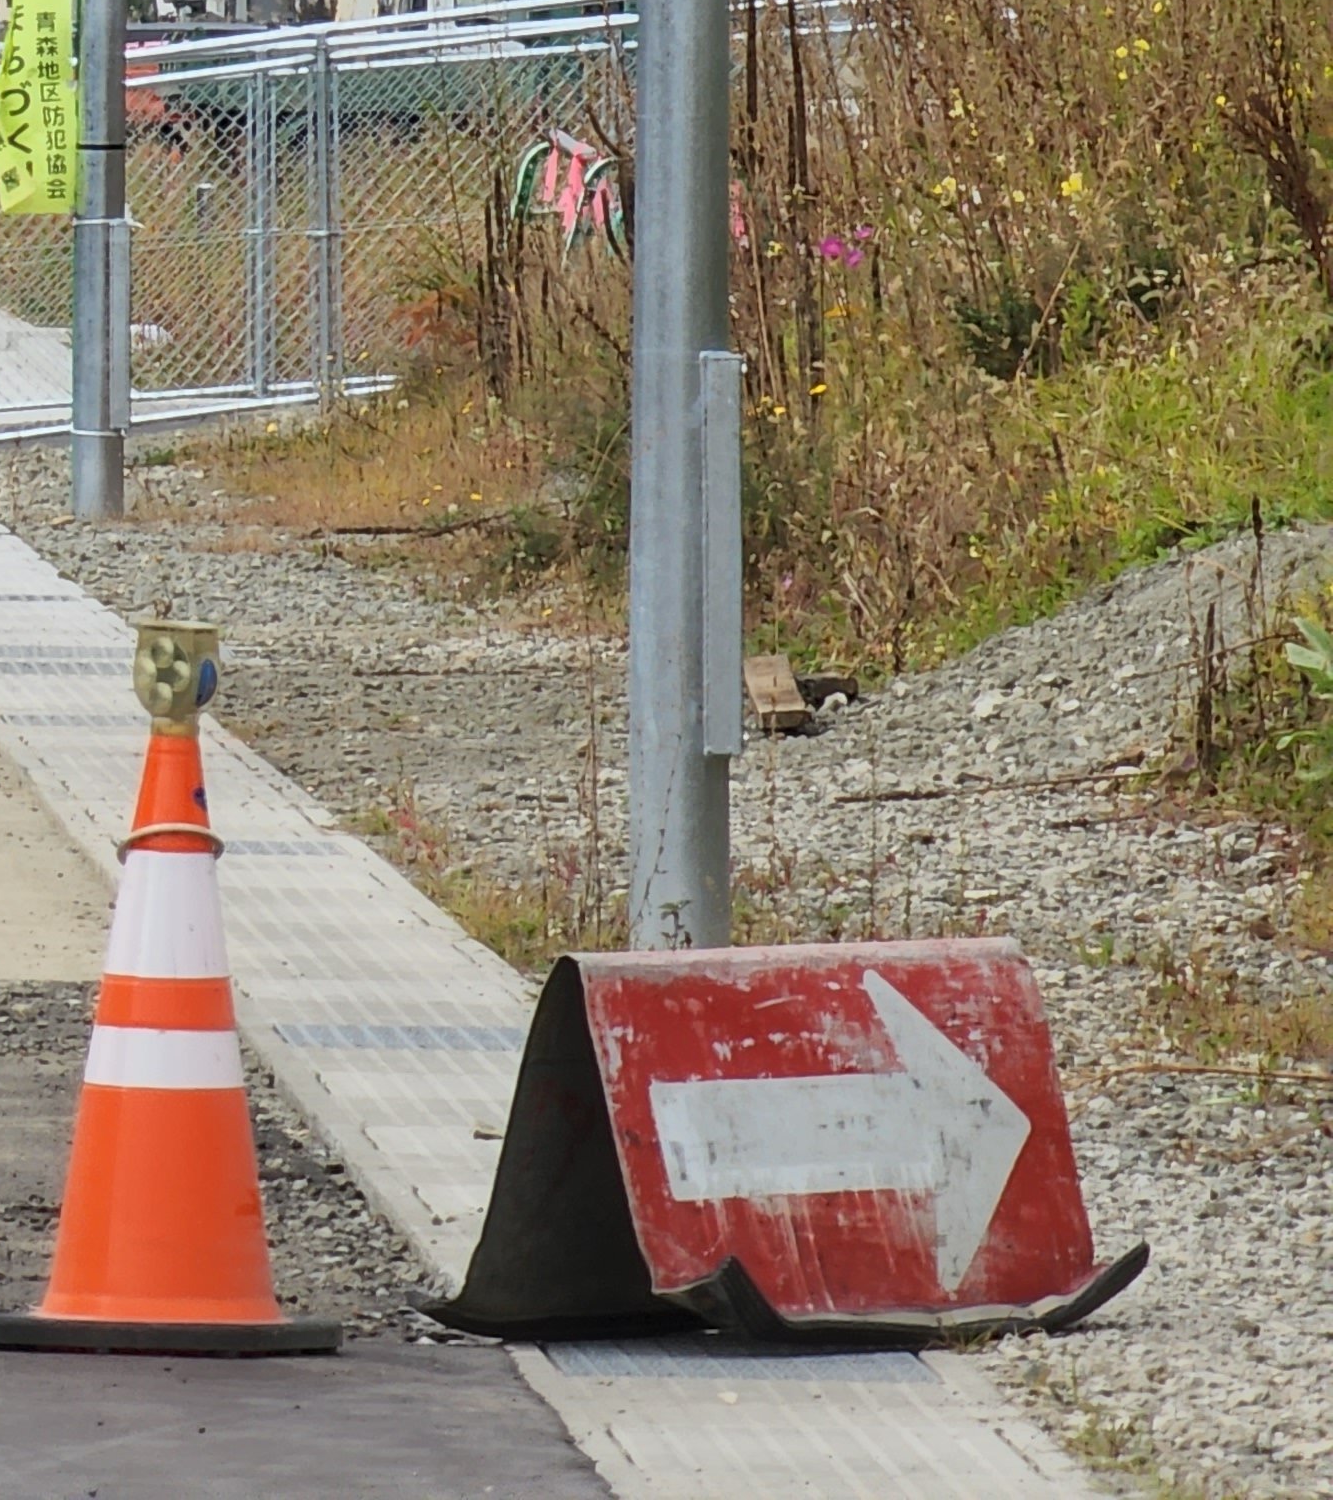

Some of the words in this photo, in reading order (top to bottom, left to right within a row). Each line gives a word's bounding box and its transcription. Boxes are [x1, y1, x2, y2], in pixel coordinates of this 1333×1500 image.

[35, 11, 68, 199] 青森地区防犯協会
